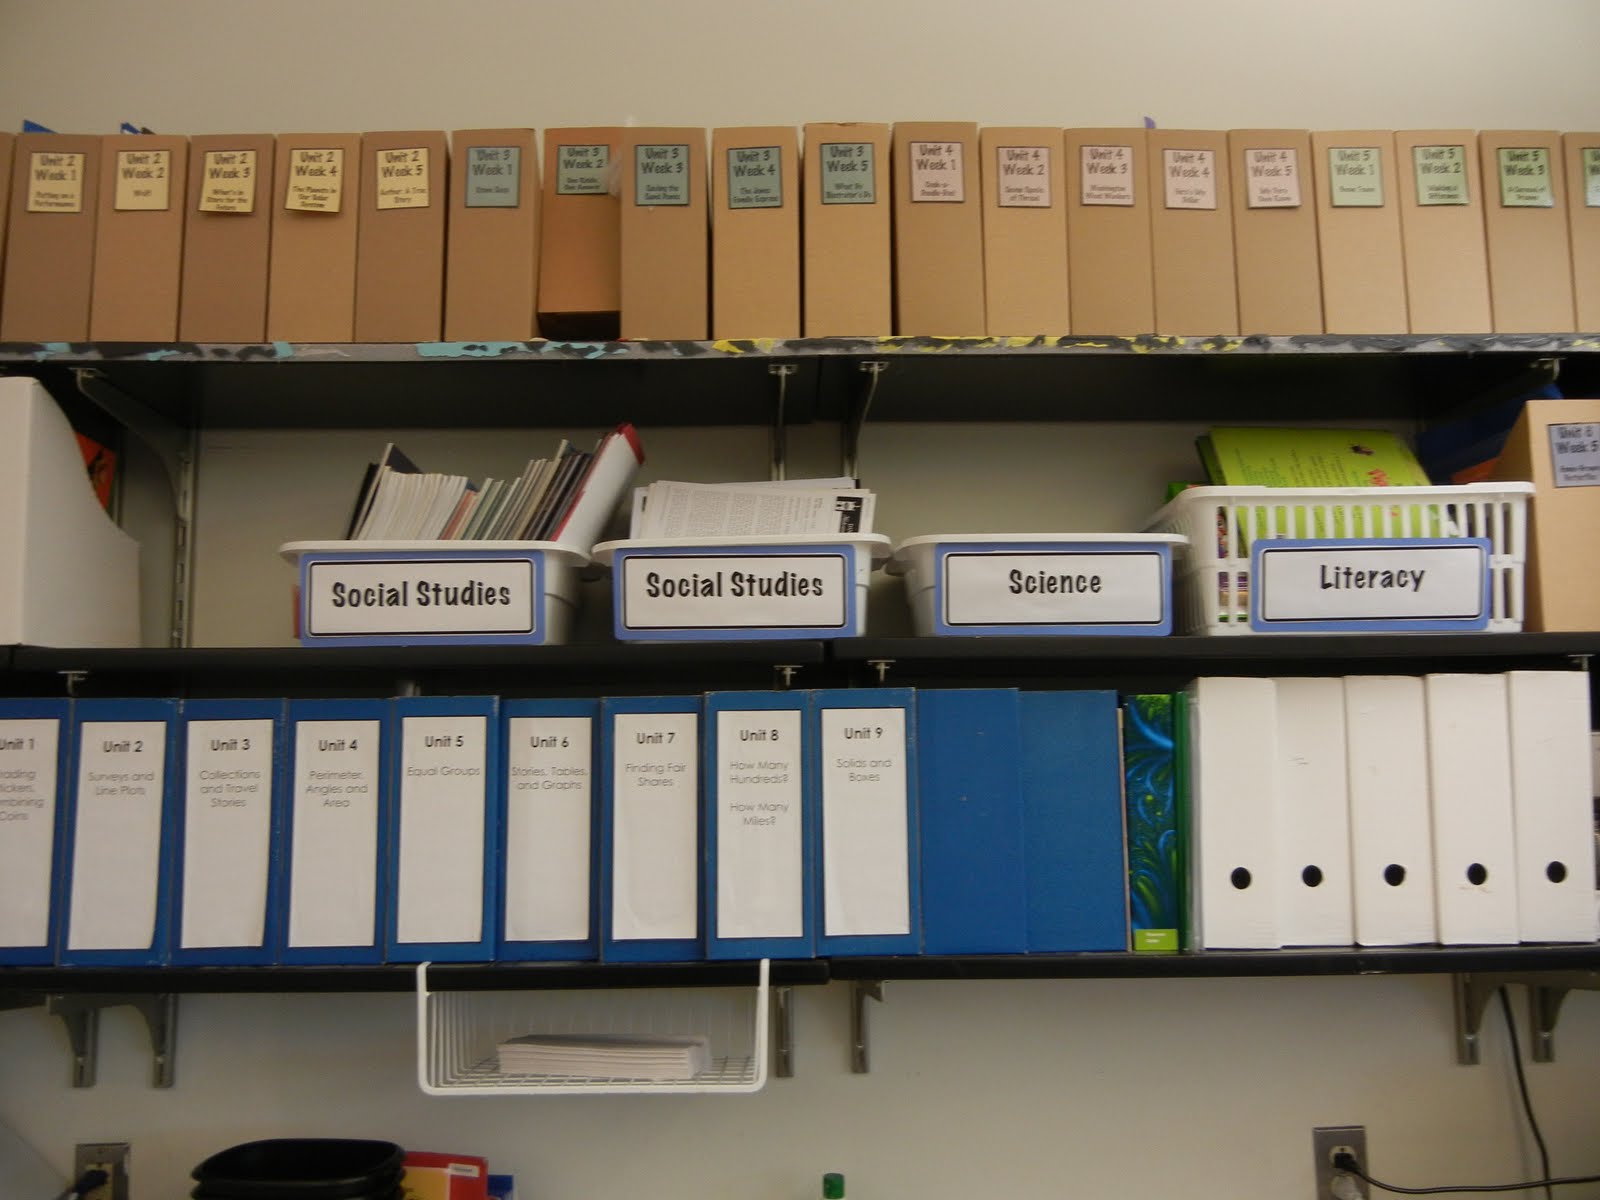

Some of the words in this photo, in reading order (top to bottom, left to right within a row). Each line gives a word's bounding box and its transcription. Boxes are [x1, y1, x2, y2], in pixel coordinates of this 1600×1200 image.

[477, 150, 500, 161] Unit
[503, 150, 510, 161] 3
[567, 148, 589, 157] Unit
[593, 148, 599, 156] 3
[645, 148, 668, 159] Unit
[672, 148, 679, 158] 3
[736, 151, 759, 161] Unit
[763, 150, 770, 161] 3
[830, 146, 853, 157] Unit
[857, 146, 864, 157] 3
[919, 145, 942, 155] Unit
[945, 145, 952, 155] 4
[1007, 150, 1029, 161] Unit
[1032, 150, 1040, 160] 4
[1089, 149, 1112, 160] Unit
[1115, 149, 1123, 160] 4
[1338, 151, 1360, 161] Unit
[1363, 150, 1370, 161] 5
[1422, 149, 1445, 160] Unit
[1448, 149, 1455, 159] 5
[1506, 151, 1529, 161] Unit
[1532, 150, 1539, 161] 5
[41, 155, 63, 166] Unit
[67, 156, 75, 166] 2
[126, 154, 150, 164] Unit
[153, 153, 161, 164] 2
[213, 154, 236, 164] Unit
[239, 153, 247, 164] 2
[301, 152, 324, 162] Unit
[327, 152, 334, 162] 2
[385, 152, 409, 163] Unit
[412, 151, 419, 161] 2
[1172, 152, 1195, 163] Unit
[1198, 152, 1205, 163] 4
[1254, 152, 1277, 163] Unit
[1279, 151, 1287, 162] 4
[473, 164, 503, 175] Week
[508, 164, 512, 175] 1
[563, 160, 591, 169] Week
[596, 160, 603, 168] 2
[641, 163, 672, 173] Week
[676, 163, 683, 173] 3
[827, 161, 858, 172] Week
[860, 161, 868, 171] 5
[915, 159, 947, 170] Week
[951, 159, 956, 170] 1
[1002, 164, 1033, 175] Week
[1037, 164, 1045, 175] 2
[1086, 163, 1117, 174] Week
[1120, 163, 1127, 173] 3
[1335, 165, 1365, 175] Week
[1369, 164, 1374, 175] 1
[1419, 163, 1450, 174] Week
[1453, 162, 1461, 173] 2
[1504, 165, 1535, 175] Week
[1538, 165, 1545, 175] 3
[35, 169, 66, 180] Week
[71, 170, 76, 180] 1
[122, 168, 153, 178] Week
[156, 168, 164, 178] 2
[210, 168, 240, 178] Week
[243, 168, 250, 178] 3
[295, 166, 326, 177] Week
[330, 166, 337, 177] 4
[382, 166, 413, 177] Week
[416, 165, 423, 175] 5
[733, 166, 766, 177] Week
[769, 165, 776, 175] 4
[1169, 166, 1199, 177] Week
[1202, 167, 1210, 177] 4
[1250, 166, 1281, 177] Week
[1284, 165, 1292, 176] 5
[1558, 427, 1581, 439] Unit
[1555, 441, 1588, 454] Week
[1592, 440, 1598, 452] 5
[1008, 569, 1102, 595] Science
[1319, 564, 1425, 592] Literacy
[646, 571, 723, 598] Social
[730, 570, 824, 597] Studies
[332, 581, 409, 608] Social
[415, 579, 511, 607] Studies
[636, 732, 662, 744] Unit
[667, 732, 676, 744] 7
[740, 729, 767, 741] Unit
[769, 729, 779, 741] 8
[844, 727, 871, 740] Unit
[875, 727, 884, 739] 9
[0, 738, 23, 750] Unit
[28, 738, 34, 750] 1
[103, 740, 130, 752] Unit
[134, 740, 144, 752] 2
[211, 739, 238, 751] Unit
[242, 739, 251, 751] 3
[318, 739, 345, 751] Unit
[349, 739, 358, 751] 4
[425, 735, 451, 748] Unit
[455, 735, 464, 748] 5
[530, 736, 557, 748] Unit
[561, 736, 570, 748] 6
[625, 762, 665, 774] Finding
[667, 762, 686, 772] Fair
[730, 761, 755, 771] How
[757, 761, 788, 772] Many
[836, 758, 868, 768] Solids
[869, 758, 892, 768] and
[0, 770, 36, 781] rading
[88, 771, 129, 782] Surveys
[131, 771, 155, 781] and
[199, 769, 261, 780] Collections
[407, 766, 438, 777] Equal
[440, 766, 481, 777] Groups
[848, 772, 880, 782] Boxes
[637, 776, 673, 787] Shares
[730, 774, 789, 784] Hundreds?
[95, 785, 118, 796] Line
[120, 785, 146, 796] Plots
[200, 783, 223, 793] and
[225, 783, 258, 793] Travel
[305, 784, 343, 795] Angles
[345, 784, 368, 793] and
[517, 780, 540, 790] and
[541, 780, 583, 791] Graphs
[210, 797, 247, 807] Stories
[322, 799, 350, 808] Area
[730, 803, 755, 812] How
[757, 803, 789, 813] Many
[743, 815, 777, 826] Miles?
